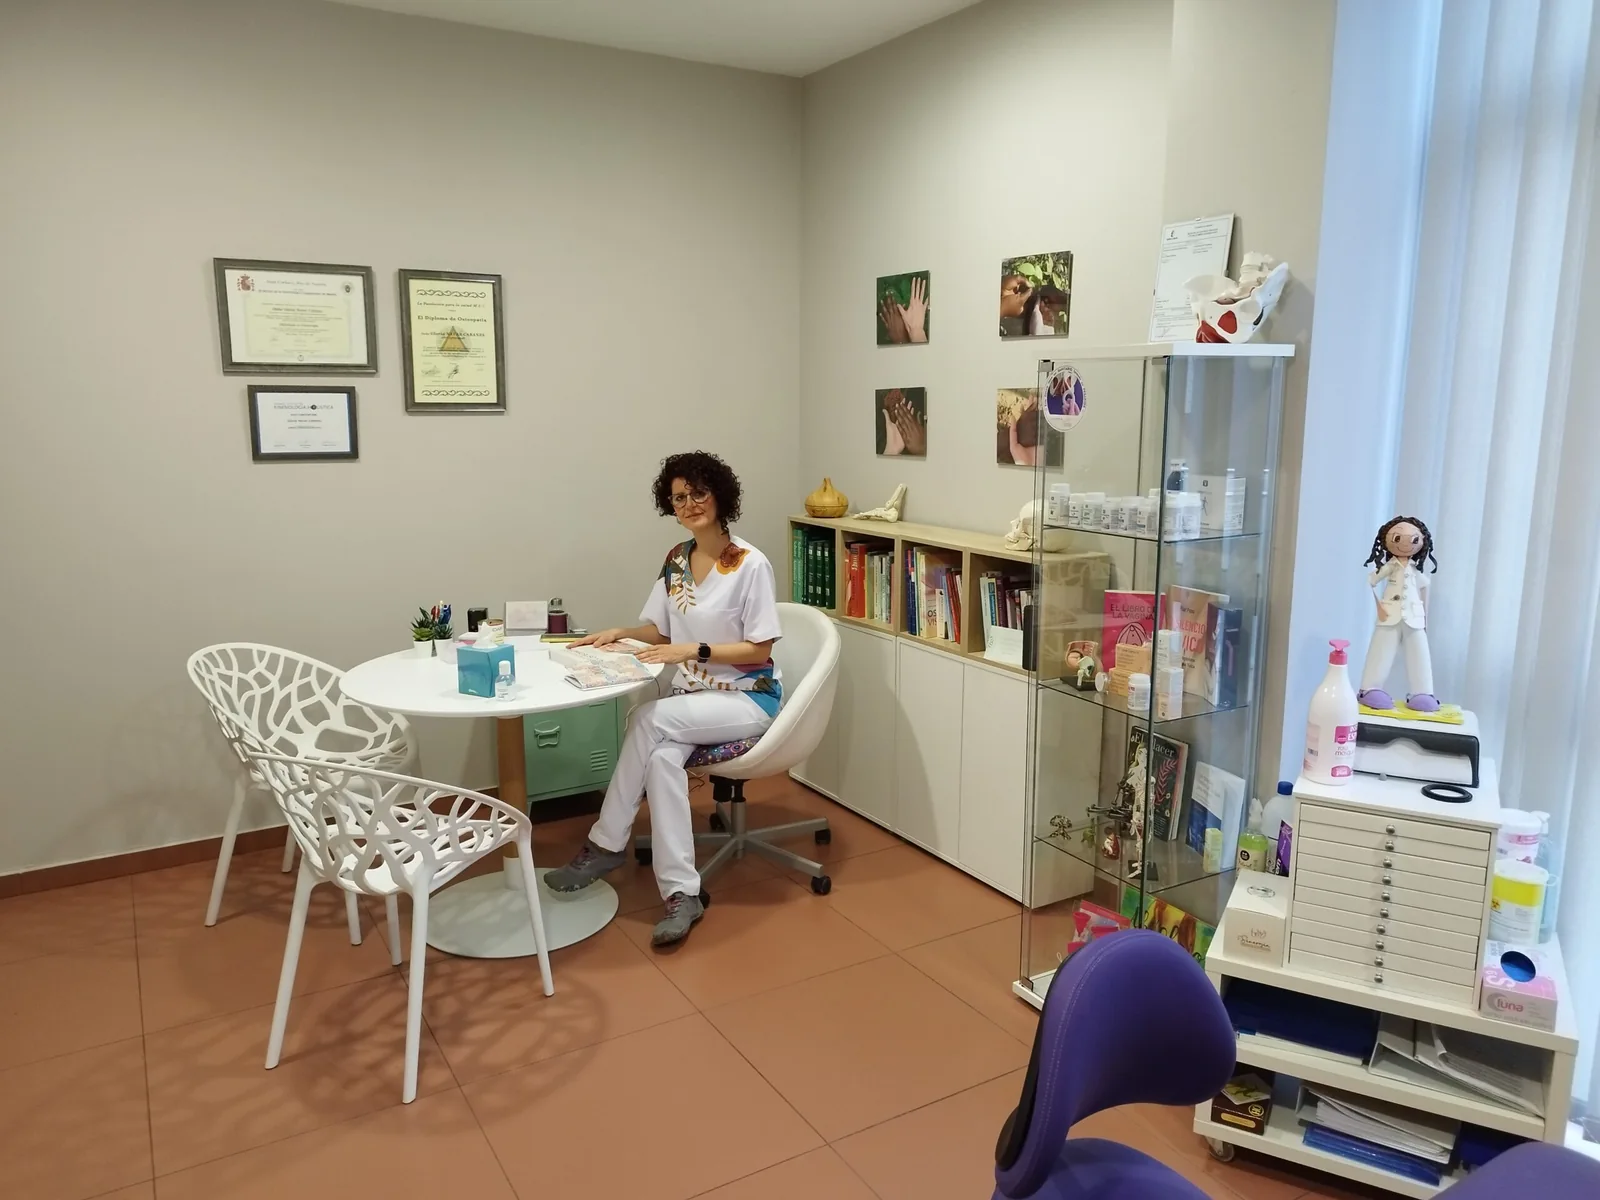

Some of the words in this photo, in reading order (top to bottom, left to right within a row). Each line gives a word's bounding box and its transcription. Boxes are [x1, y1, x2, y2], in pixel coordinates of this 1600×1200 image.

[1110, 604, 1120, 612] EL
[1122, 604, 1145, 613] LIBRO
[1112, 611, 1123, 619] LA
[1152, 739, 1175, 757] lacer
[1496, 998, 1524, 1013] luna
